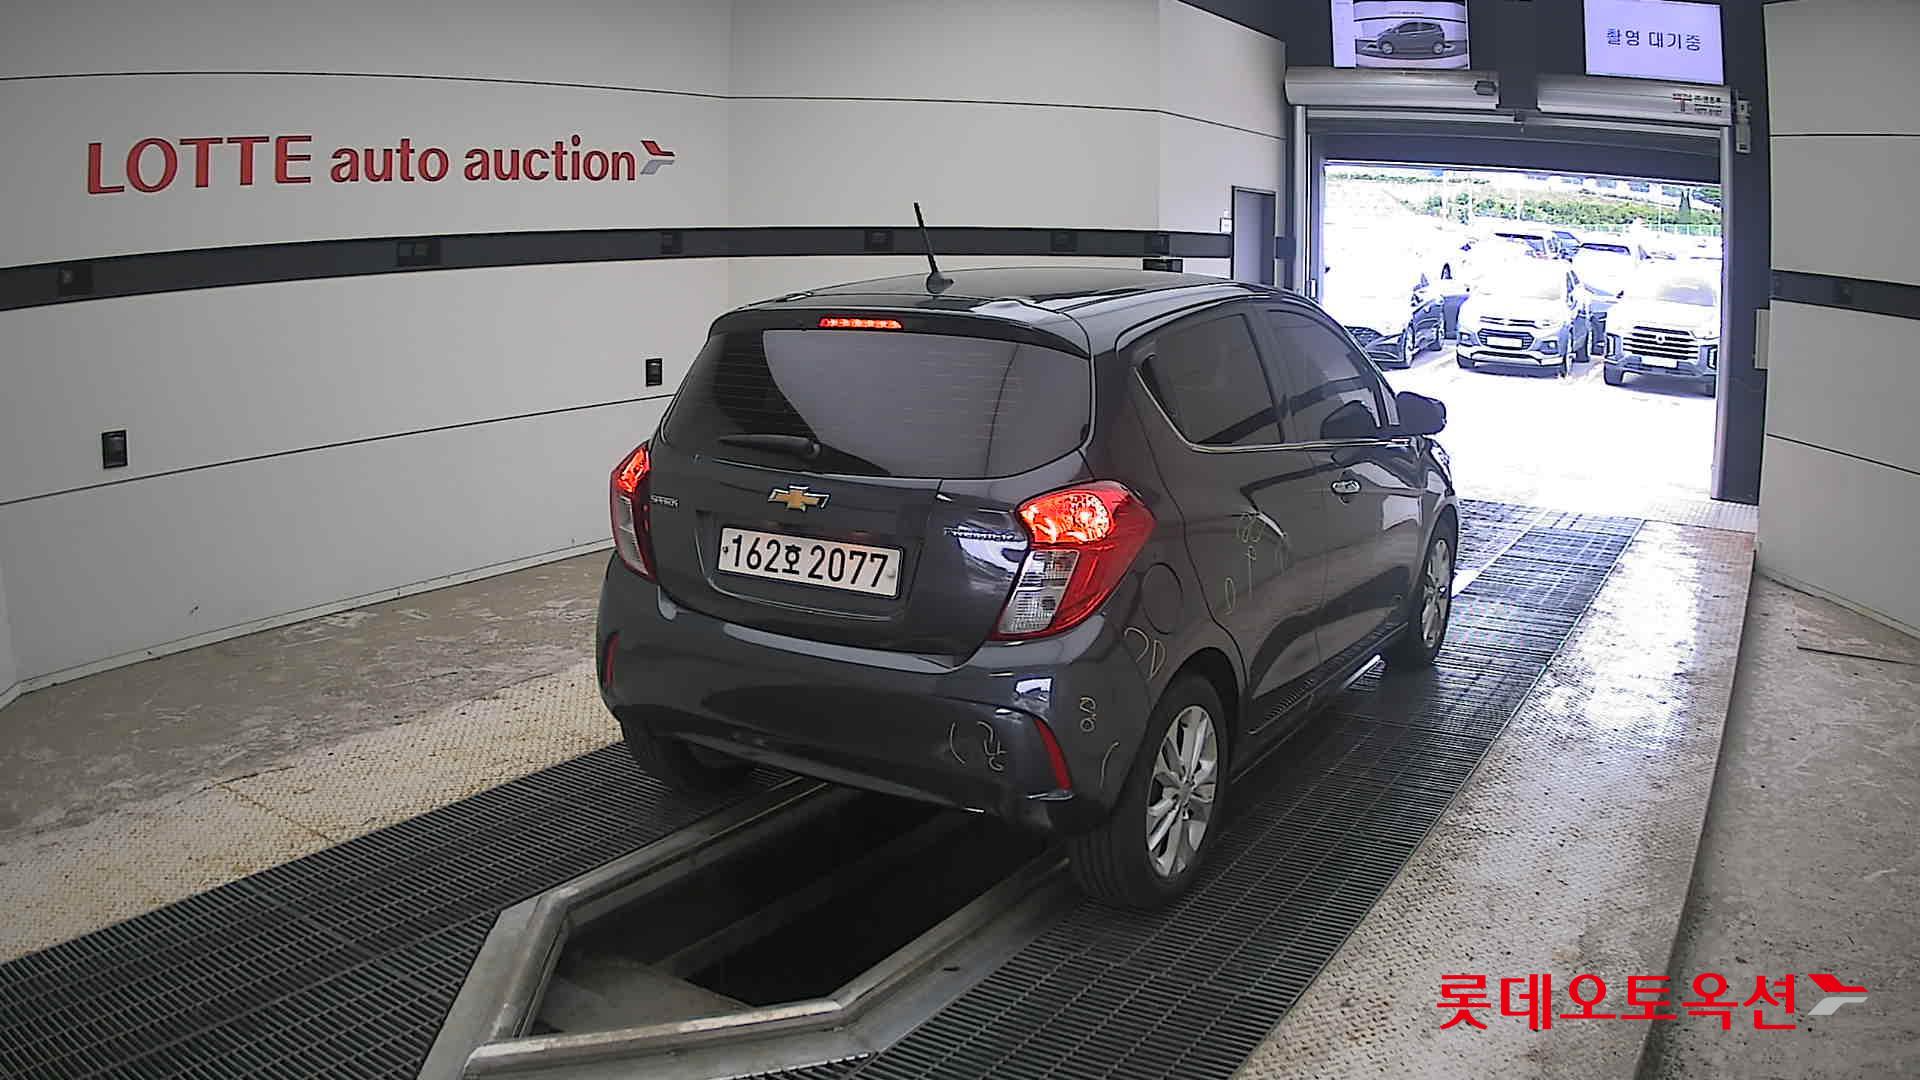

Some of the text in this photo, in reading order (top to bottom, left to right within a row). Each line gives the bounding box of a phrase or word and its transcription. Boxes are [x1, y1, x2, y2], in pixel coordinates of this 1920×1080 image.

[1648, 31, 1702, 52] 대기중
[87, 133, 637, 194] LOTTE auto auction
